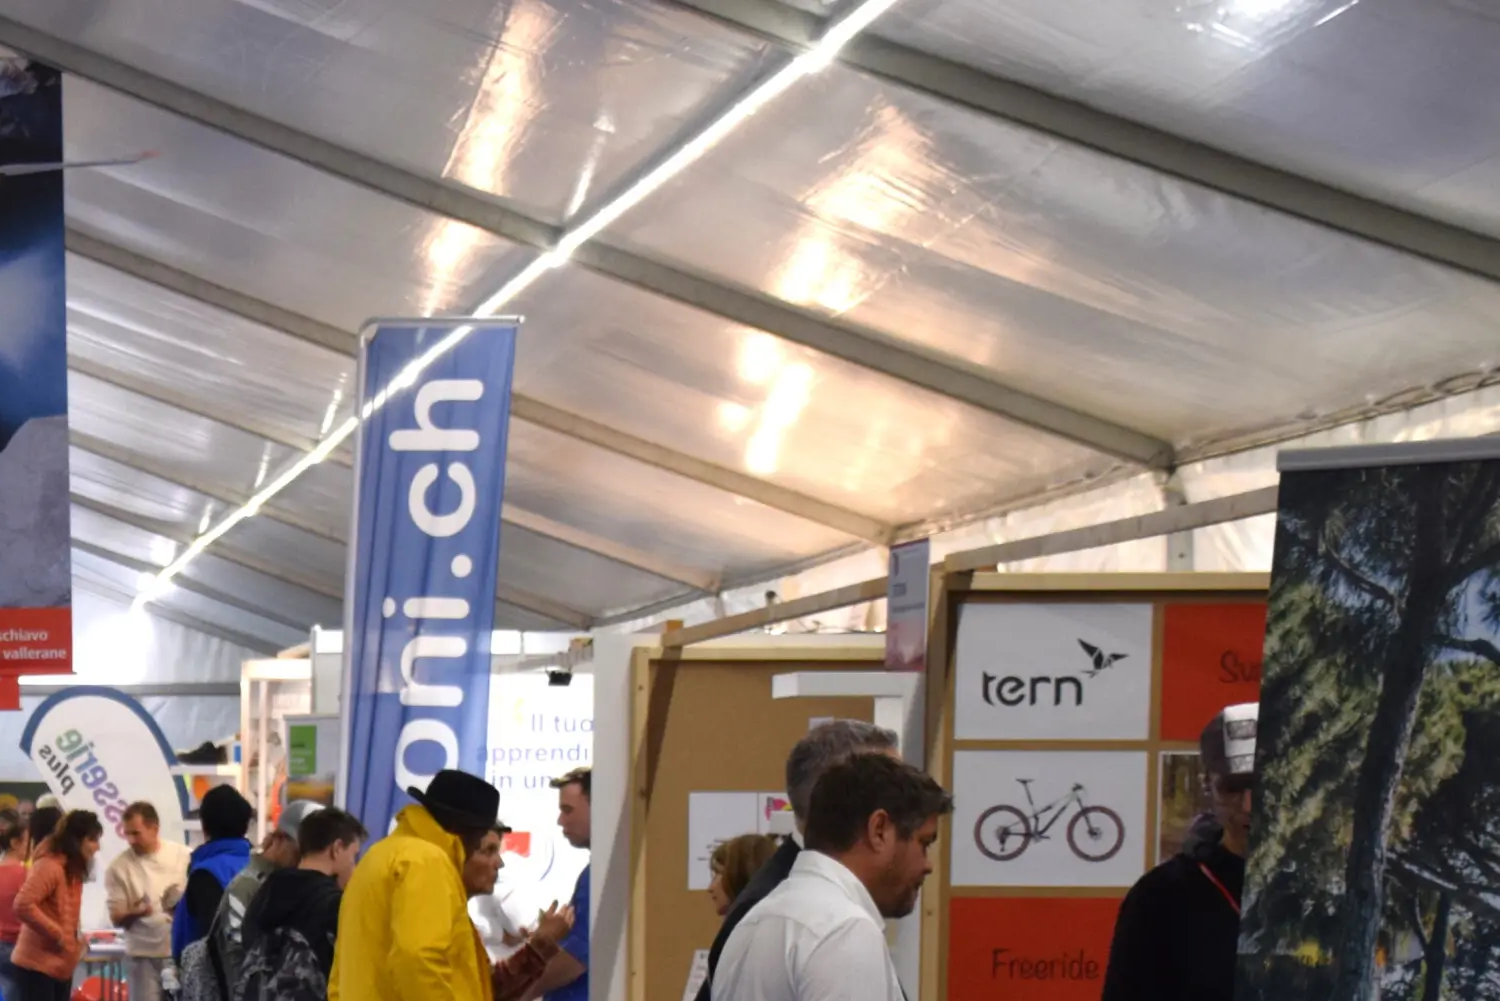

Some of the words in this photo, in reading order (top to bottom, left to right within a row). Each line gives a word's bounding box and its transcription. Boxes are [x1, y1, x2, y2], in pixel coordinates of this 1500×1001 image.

[383, 378, 485, 820] oni.ch
[3, 647, 67, 660] vallerane
[982, 671, 1083, 706] tern
[992, 948, 1100, 980] Freeride
